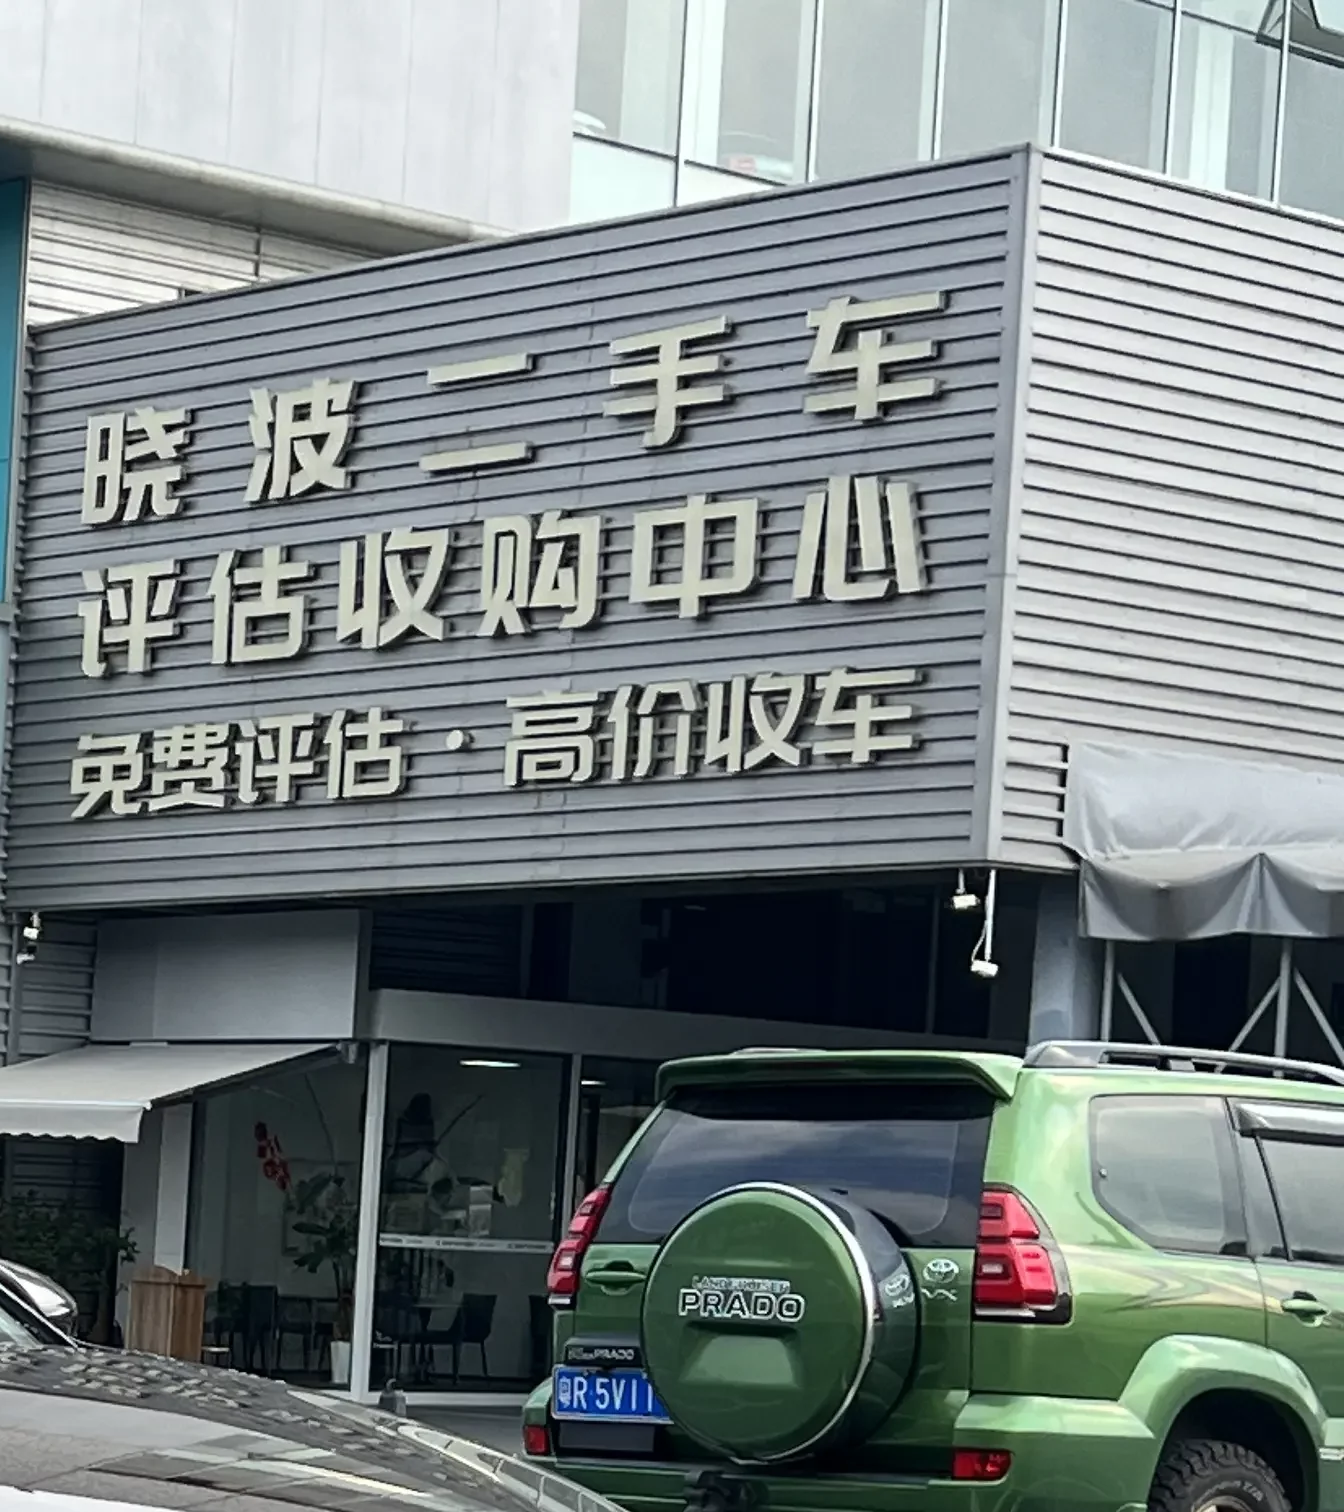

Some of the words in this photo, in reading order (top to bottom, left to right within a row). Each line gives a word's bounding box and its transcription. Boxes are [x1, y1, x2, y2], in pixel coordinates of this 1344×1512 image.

[80, 290, 948, 527] 晓波二手车
[77, 475, 928, 678] 评估收购中心
[678, 1288, 805, 1322] PRADO
